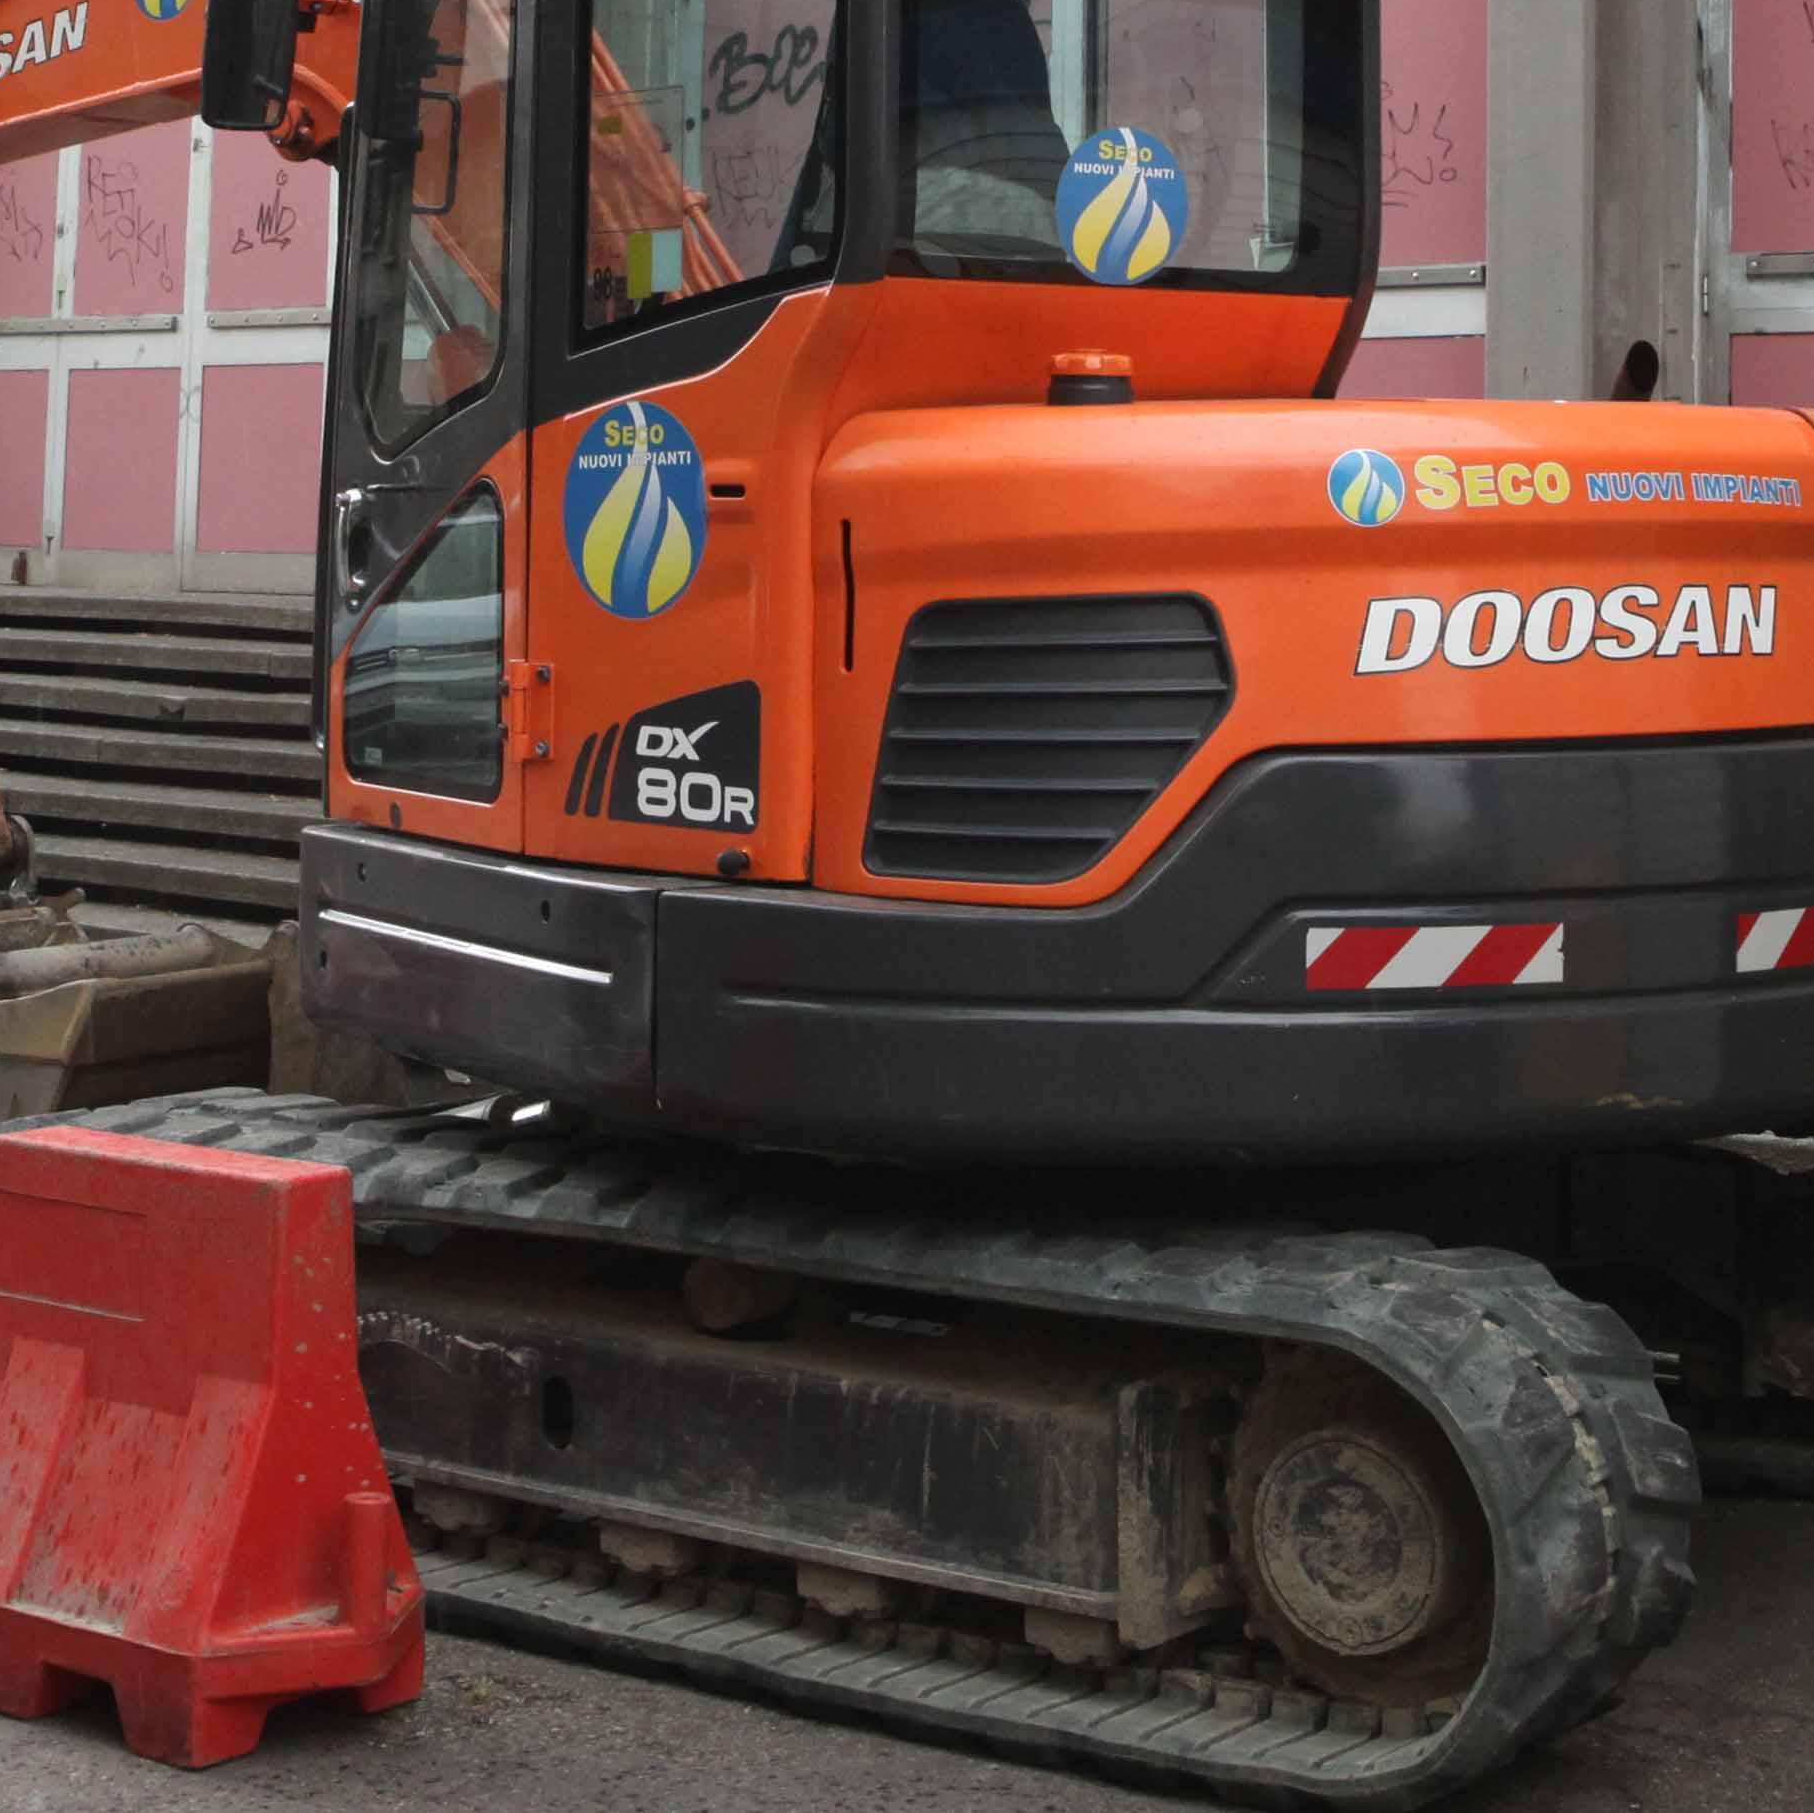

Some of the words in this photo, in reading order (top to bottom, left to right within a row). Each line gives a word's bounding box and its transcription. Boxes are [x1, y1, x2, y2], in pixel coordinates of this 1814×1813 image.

[1074, 163, 1114, 175] NUOVI
[579, 454, 622, 469] NUOVI
[1414, 454, 1571, 510] SECO
[1586, 472, 1685, 502] NUOVI
[1691, 473, 1802, 507] IMPIANTI
[1354, 584, 1777, 676] DOOSAN
[636, 721, 720, 761] DX
[637, 767, 755, 826] 80R
